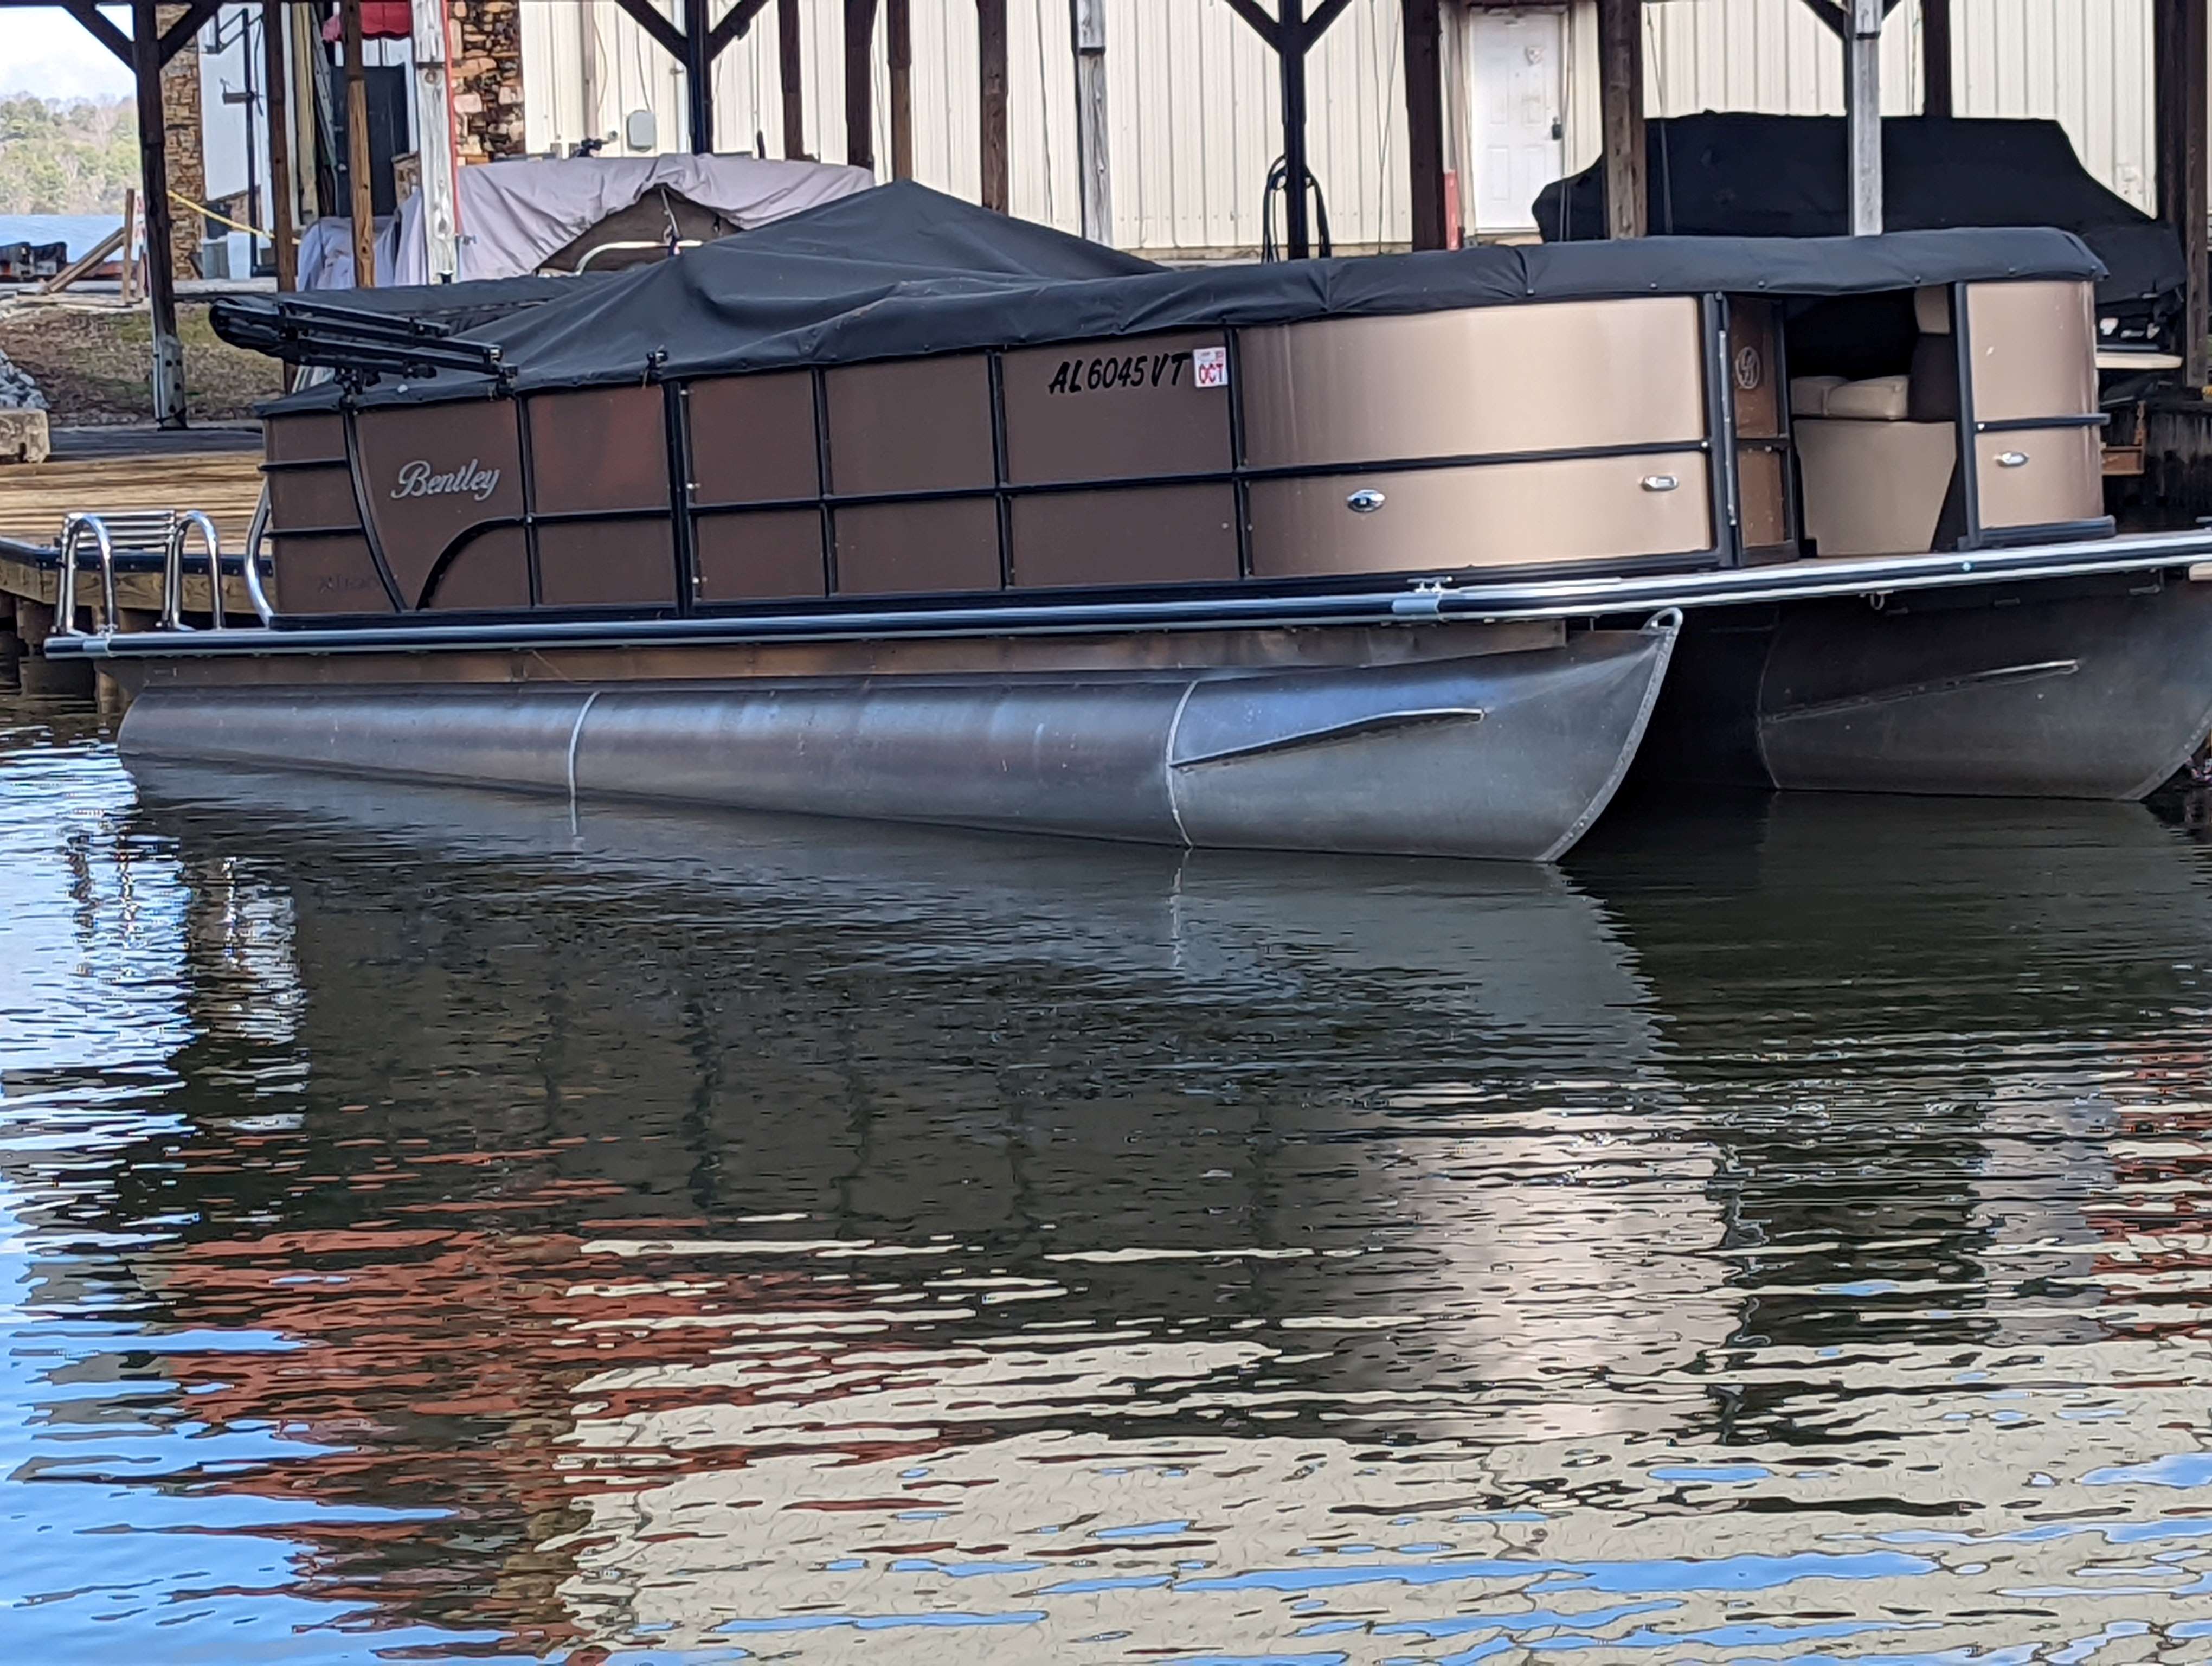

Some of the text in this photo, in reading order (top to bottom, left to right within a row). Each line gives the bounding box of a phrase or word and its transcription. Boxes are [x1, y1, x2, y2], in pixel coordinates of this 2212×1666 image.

[1049, 360, 1083, 394] AL
[1088, 356, 1148, 390] 6045
[1198, 363, 1224, 384] OCT
[390, 458, 500, 501] Bentley
